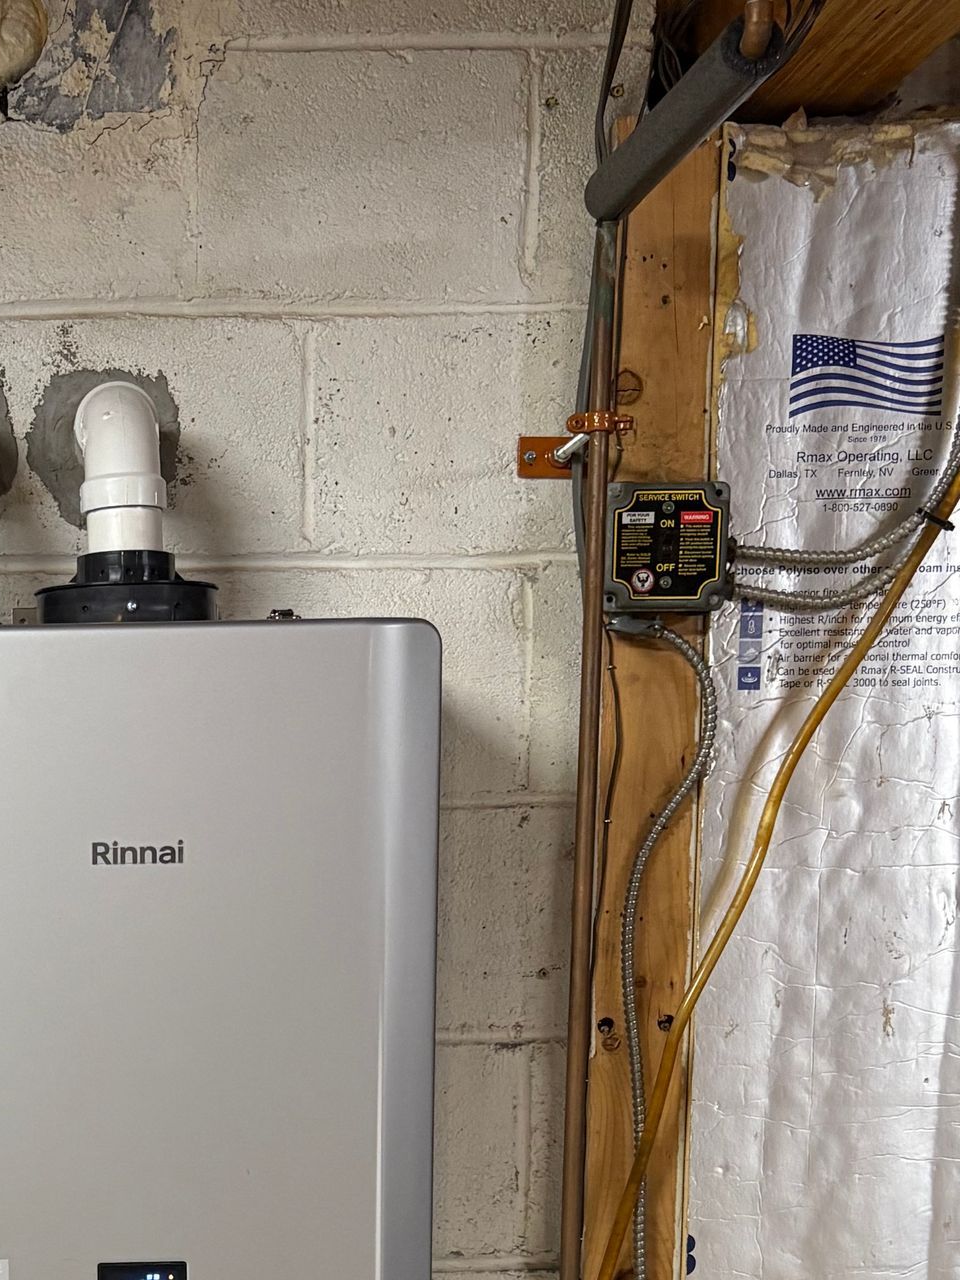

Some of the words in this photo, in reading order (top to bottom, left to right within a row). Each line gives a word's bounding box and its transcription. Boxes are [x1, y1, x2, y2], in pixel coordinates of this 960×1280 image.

[766, 424, 800, 435] Proudly
[803, 424, 828, 433] Made
[831, 424, 848, 433] and
[852, 423, 904, 435] Engineered
[907, 422, 917, 431] in
[917, 421, 931, 431] the
[870, 434, 886, 443] 1978
[797, 451, 832, 464] Rmax
[836, 450, 902, 465] Operating,
[908, 448, 933, 461] LLC
[769, 468, 802, 481] Dallas,
[804, 469, 817, 478] TX
[838, 467, 875, 481] Fernley,
[879, 467, 894, 477] NV
[816, 486, 912, 499] www.rmax.com
[823, 502, 898, 514] 1-800-527-0890
[660, 520, 674, 528] ON
[656, 564, 675, 572] OFF
[778, 565, 820, 579] Polyiso
[852, 564, 882, 575] other
[779, 614, 816, 627] Highest
[778, 628, 821, 637] Excellent
[892, 652, 927, 661] thermal
[889, 664, 923, 674] R-SEAL
[779, 679, 801, 689] Tape
[853, 678, 876, 687] 3000
[892, 678, 910, 686] seal
[912, 677, 941, 688] joints.
[92, 840, 183, 865] Rinnai
